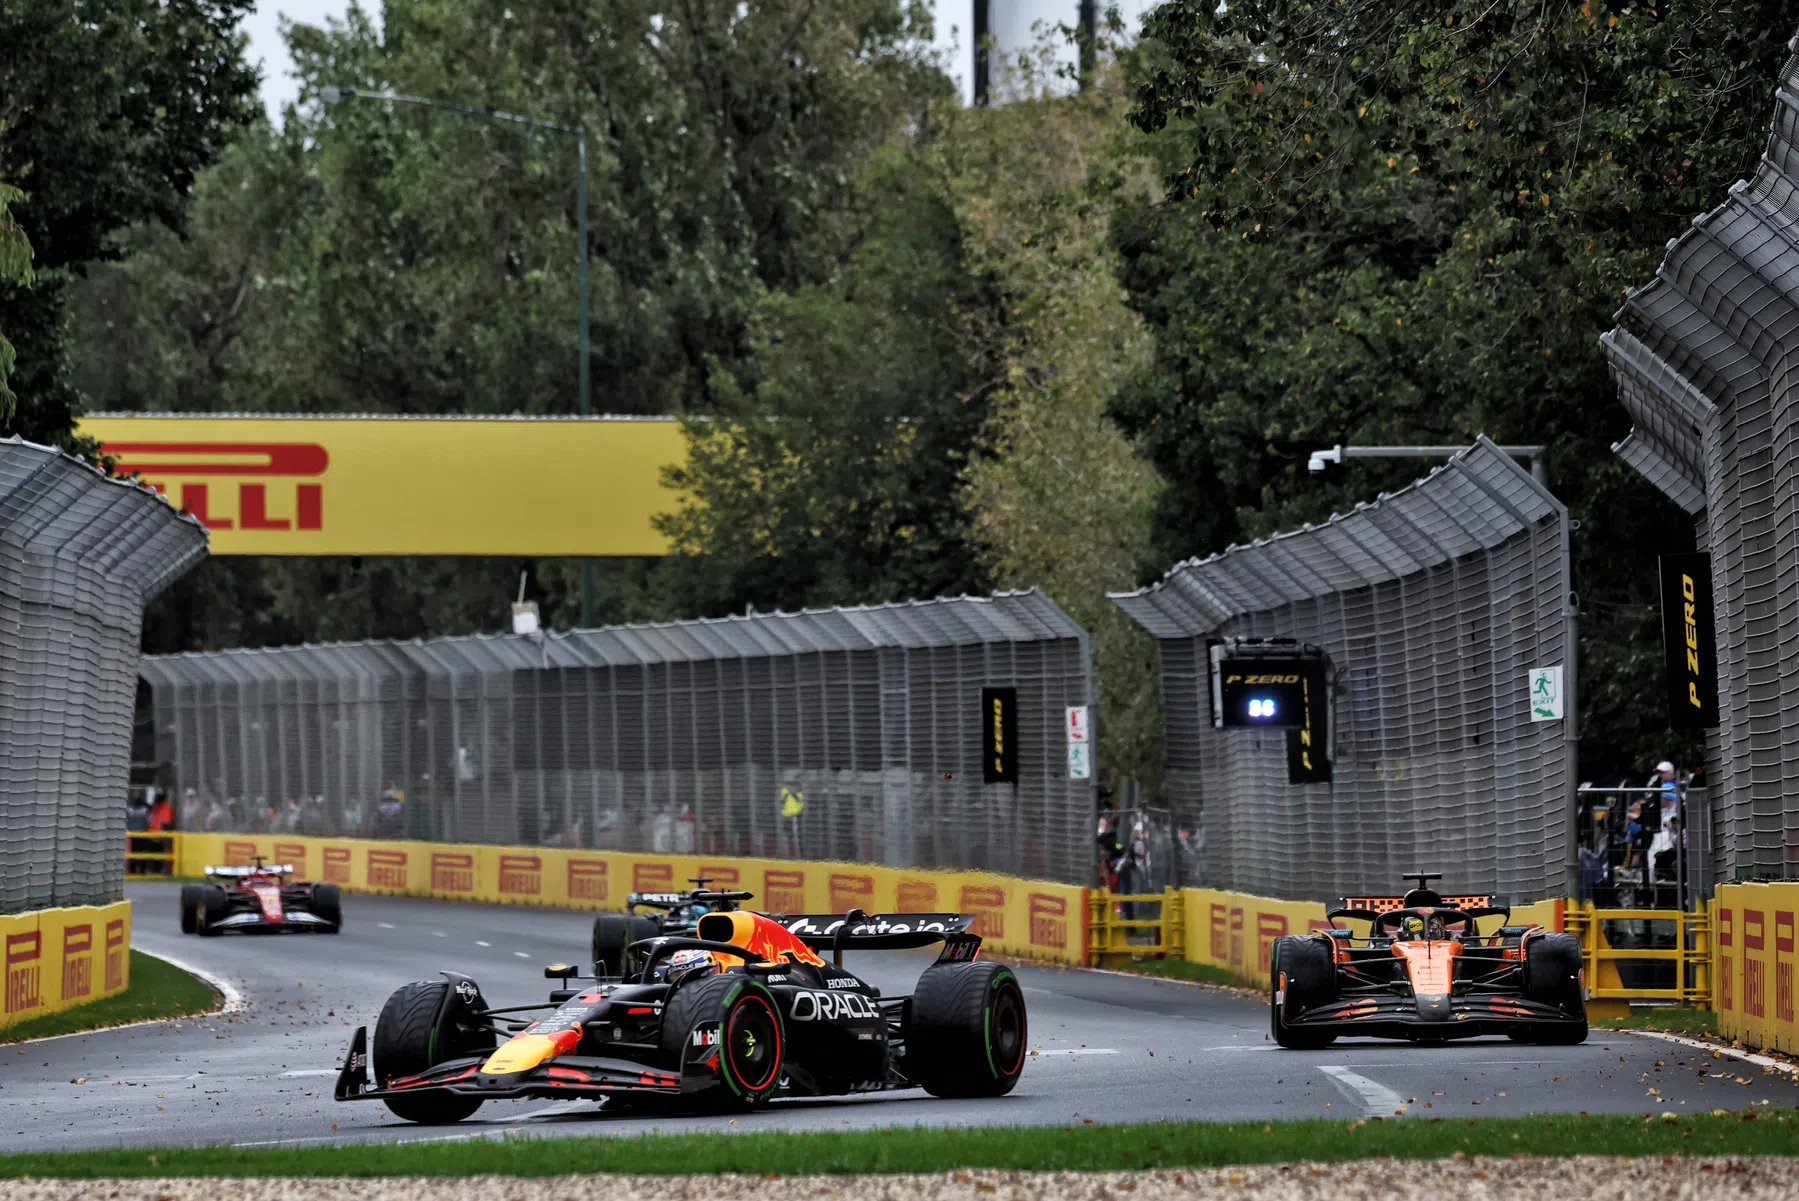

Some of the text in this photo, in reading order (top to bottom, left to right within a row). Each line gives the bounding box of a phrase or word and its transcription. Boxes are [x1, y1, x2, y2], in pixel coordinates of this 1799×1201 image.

[98, 442, 330, 531] PLLI
[1682, 573, 1701, 709] P ZERO
[1226, 674, 1301, 684] P ZERO
[4, 929, 41, 1014] PIRELLI
[827, 977, 861, 989] HONDA
[789, 990, 880, 1022] ORACLE
[692, 1029, 720, 1047] Mobil
